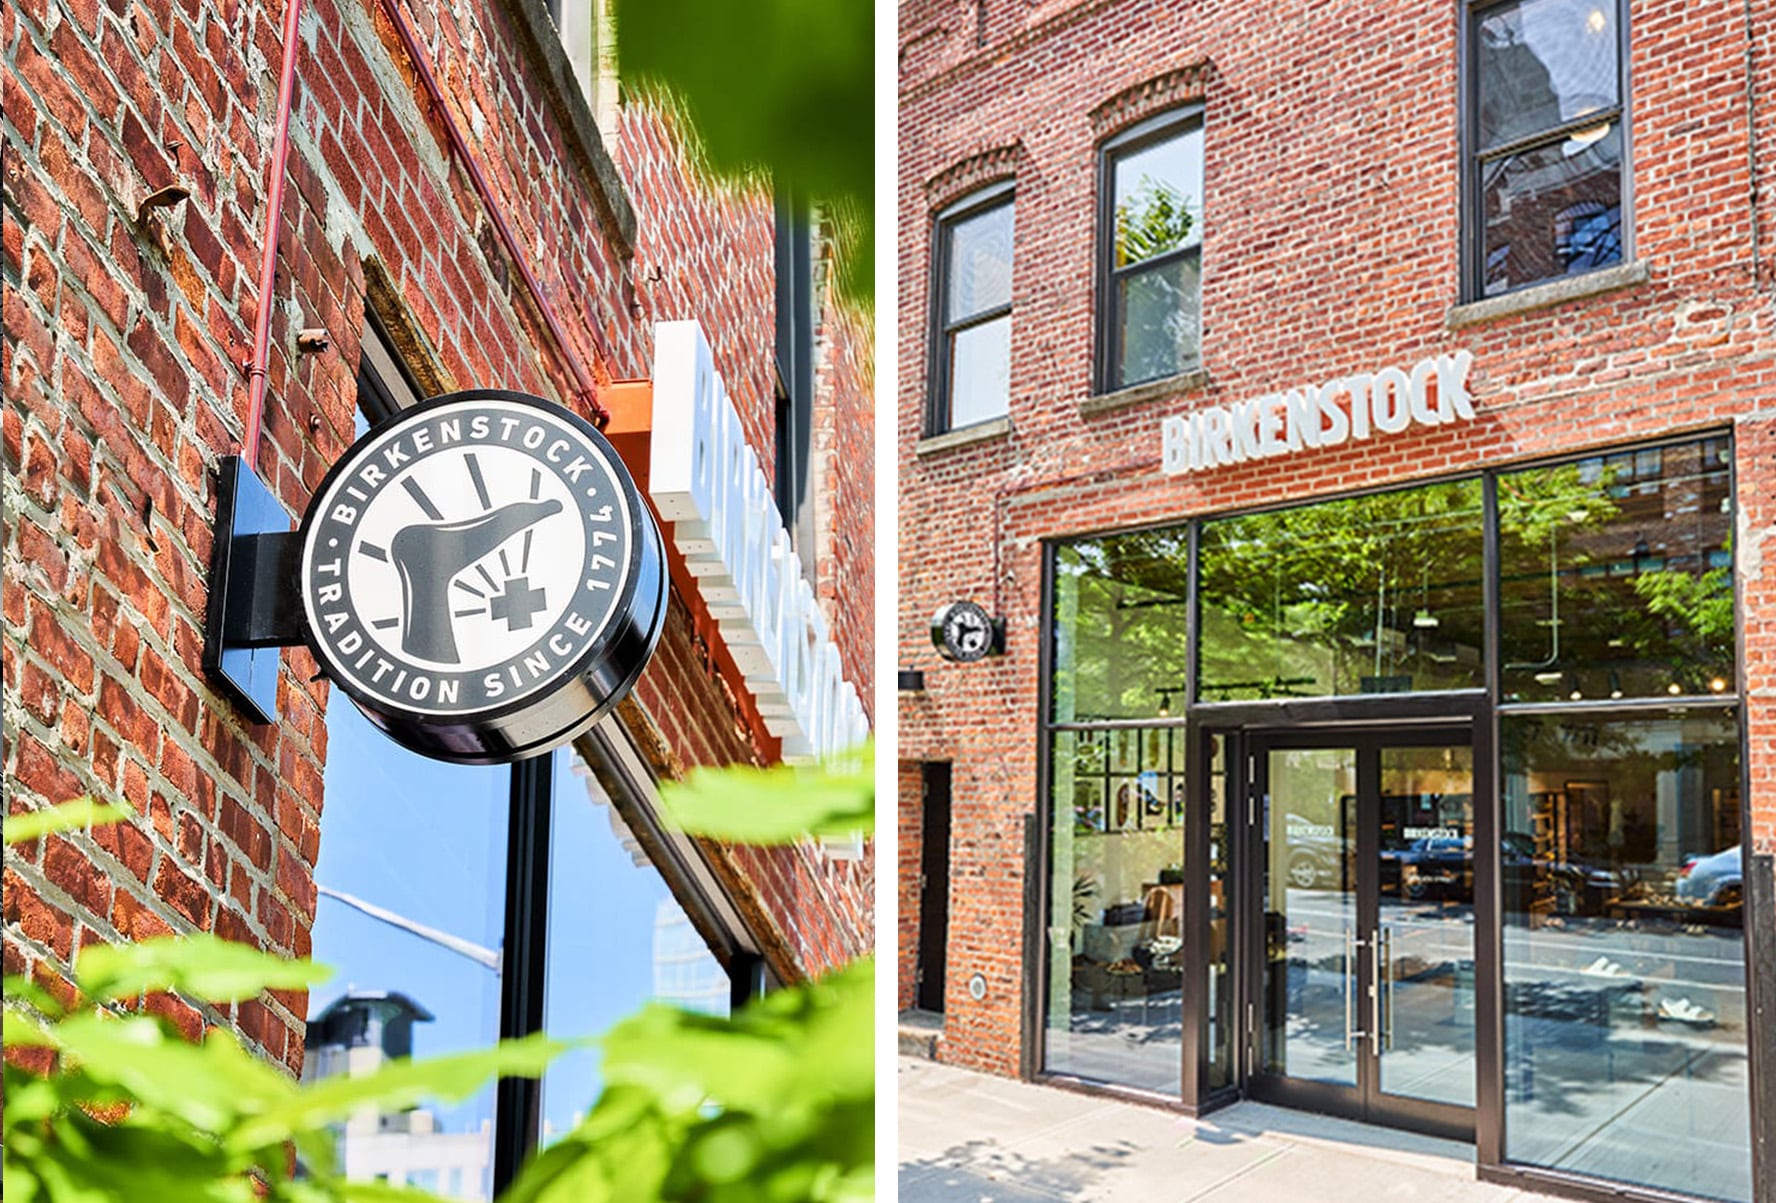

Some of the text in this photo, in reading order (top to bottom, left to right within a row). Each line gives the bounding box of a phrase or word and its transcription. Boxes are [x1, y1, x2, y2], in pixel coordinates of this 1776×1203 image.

[331, 416, 593, 526] BIRKENSTOCK
[1162, 350, 1476, 476] BIRKENSTOCK
[317, 504, 618, 703] TRADITION SINCE 1774
